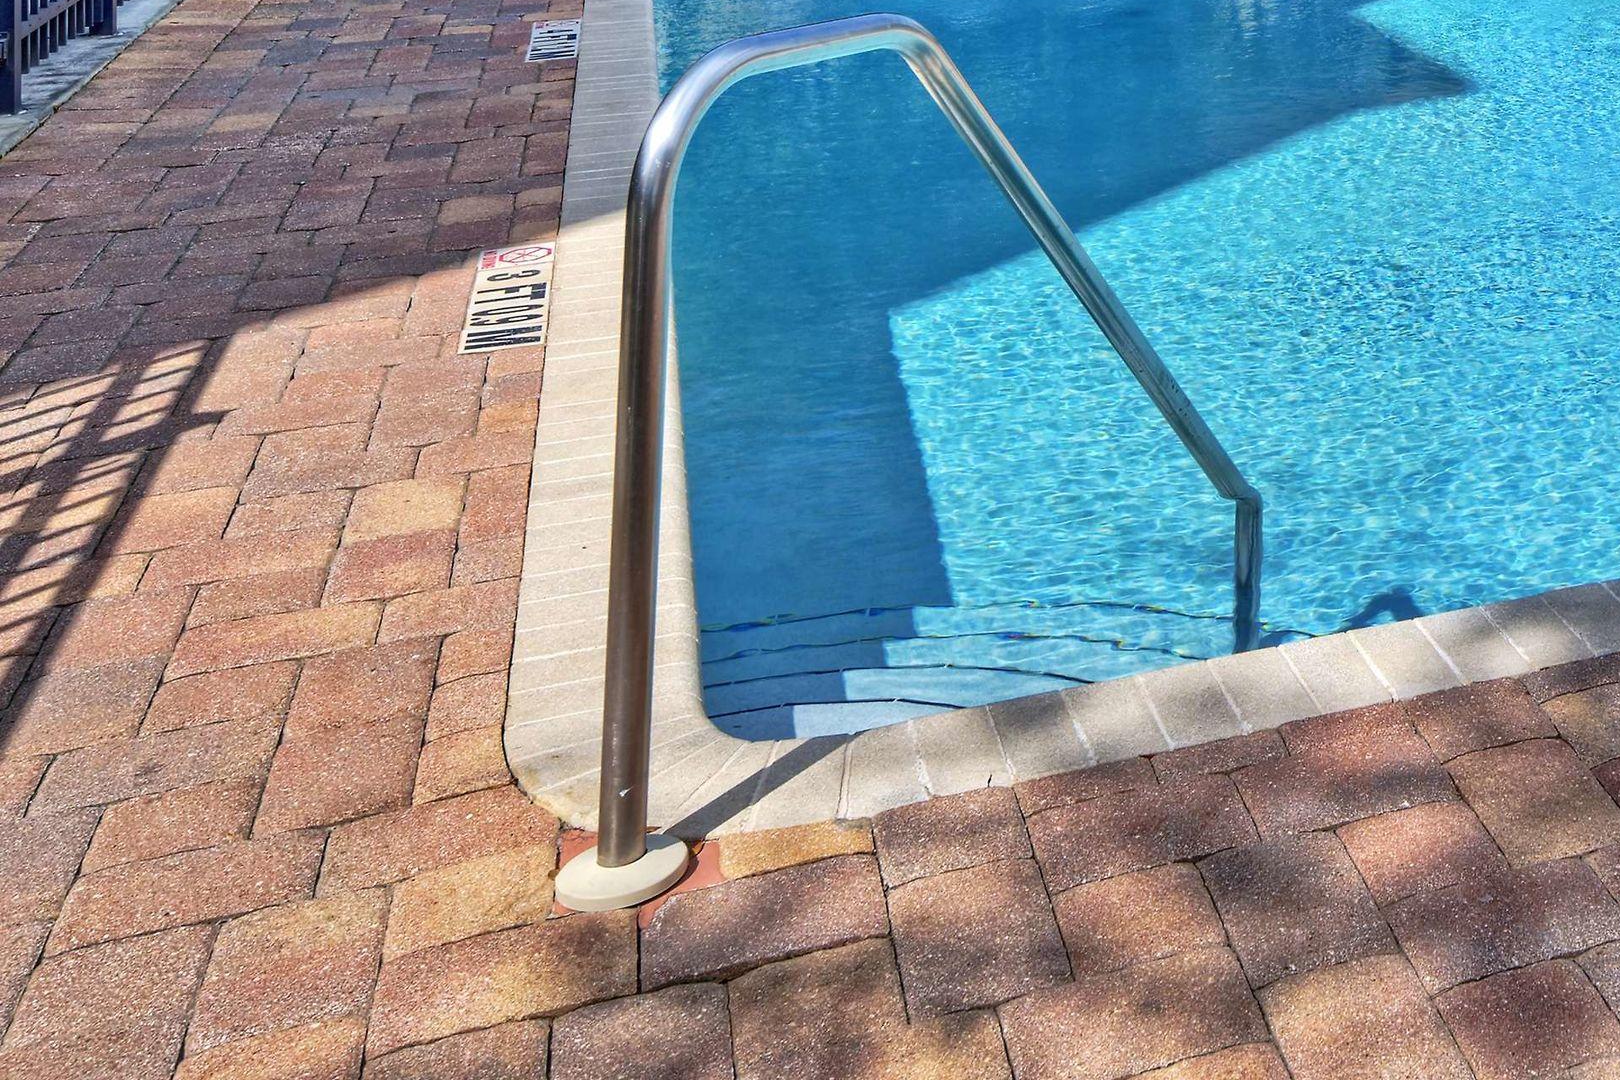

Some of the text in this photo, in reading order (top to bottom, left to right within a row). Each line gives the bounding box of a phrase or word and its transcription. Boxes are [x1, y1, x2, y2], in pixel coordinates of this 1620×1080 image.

[487, 269, 541, 281] 3
[475, 282, 547, 304] FT
[464, 325, 542, 350] M
